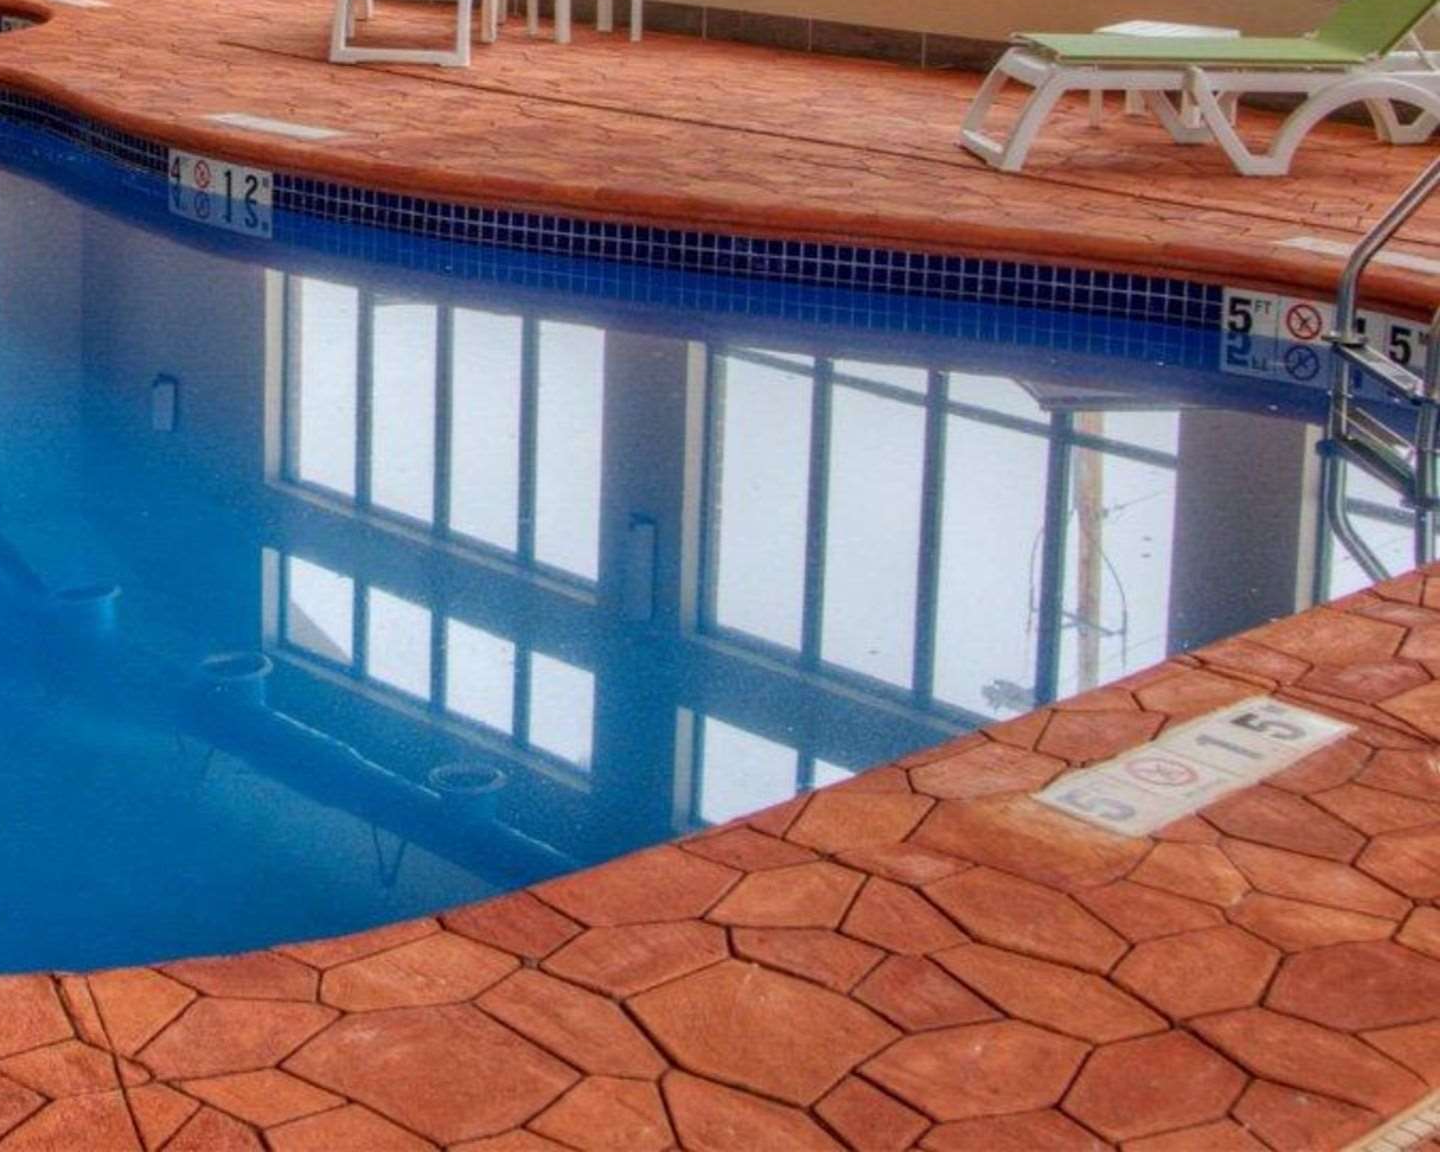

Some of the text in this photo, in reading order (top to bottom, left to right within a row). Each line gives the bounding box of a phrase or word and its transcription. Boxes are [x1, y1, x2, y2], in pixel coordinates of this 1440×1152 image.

[170, 157, 181, 184] 4
[1227, 296, 1252, 334] 5
[1254, 299, 1272, 314] FT
